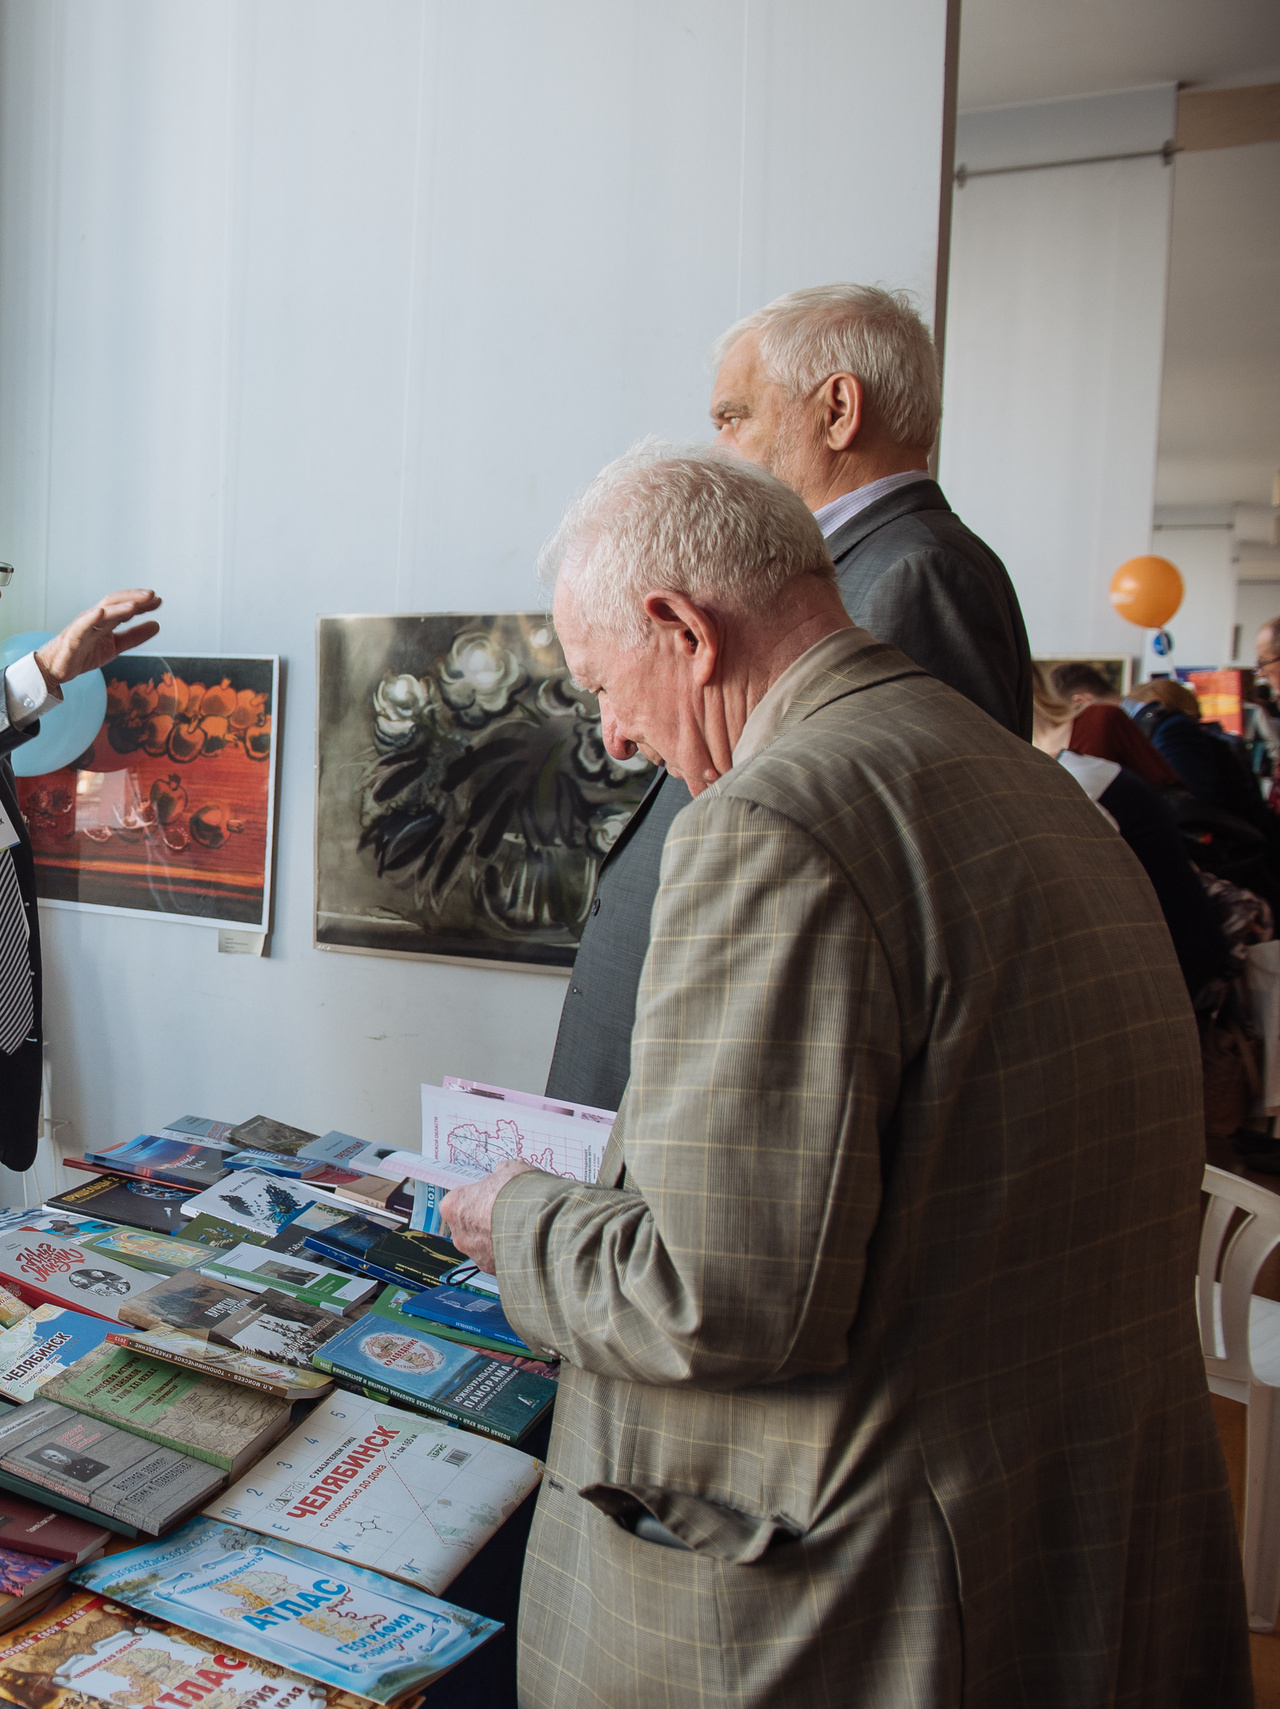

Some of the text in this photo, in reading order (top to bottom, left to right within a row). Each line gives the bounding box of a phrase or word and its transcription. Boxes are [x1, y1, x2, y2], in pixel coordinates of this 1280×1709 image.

[2, 1330, 73, 1384] ЧЕЛЯБИНСК
[133, 1341, 172, 1360] КРАЕВЕДЕНИЕ
[382, 1338, 419, 1368] КРАЕВЕДЕНИЕ
[173, 1354, 226, 1377] ТОПОНИМИЧЕСКОЕ
[332, 1366, 367, 1386] ДОСТИЖЕНИЙ
[233, 1374, 261, 1388] МОИСЕЕВ
[453, 1361, 500, 1403] ЮЖНОУРАЛЬСКАЯ
[462, 1364, 513, 1409] ПАНОРАМА
[389, 1389, 417, 1405] ПАНОРАМА
[331, 1409, 347, 1420] 5
[416, 1398, 459, 1422] ЮЖНОУРАЛЬСКАЯ
[462, 1416, 476, 1428] КРАЙ
[476, 1422, 490, 1433] СВОЙ
[304, 1436, 320, 1447] 4
[490, 1427, 511, 1441] ПОЗНАЙ
[266, 1479, 310, 1513] КАРТА
[315, 1446, 348, 1474] УКАЗАТЕЛЕМ
[342, 1436, 359, 1453] УЛИЦ
[276, 1460, 293, 1471] 3
[286, 1424, 401, 1522] ЧЕЛЯБИНСК
[246, 1487, 264, 1498] 2
[326, 1487, 362, 1522] ТОЧНОСТЬЮ
[359, 1477, 372, 1490] ДО
[271, 1522, 291, 1533] Е
[187, 1530, 219, 1554] КРАЙ
[332, 1540, 356, 1555] Ж
[177, 1555, 264, 1596] ЧЕЛЯБИНСКАЯ ОБЛАСТЬ
[240, 1577, 348, 1632] АТЛАС
[35, 1622, 61, 1643] СВОЙ
[61, 1609, 87, 1628] КРАЙ
[336, 1614, 416, 1656] ГЕОГРАФИЯ
[115, 1637, 144, 1657] ОБЛАСТЬ
[358, 1621, 427, 1660] РОДНОГО КРАЯ
